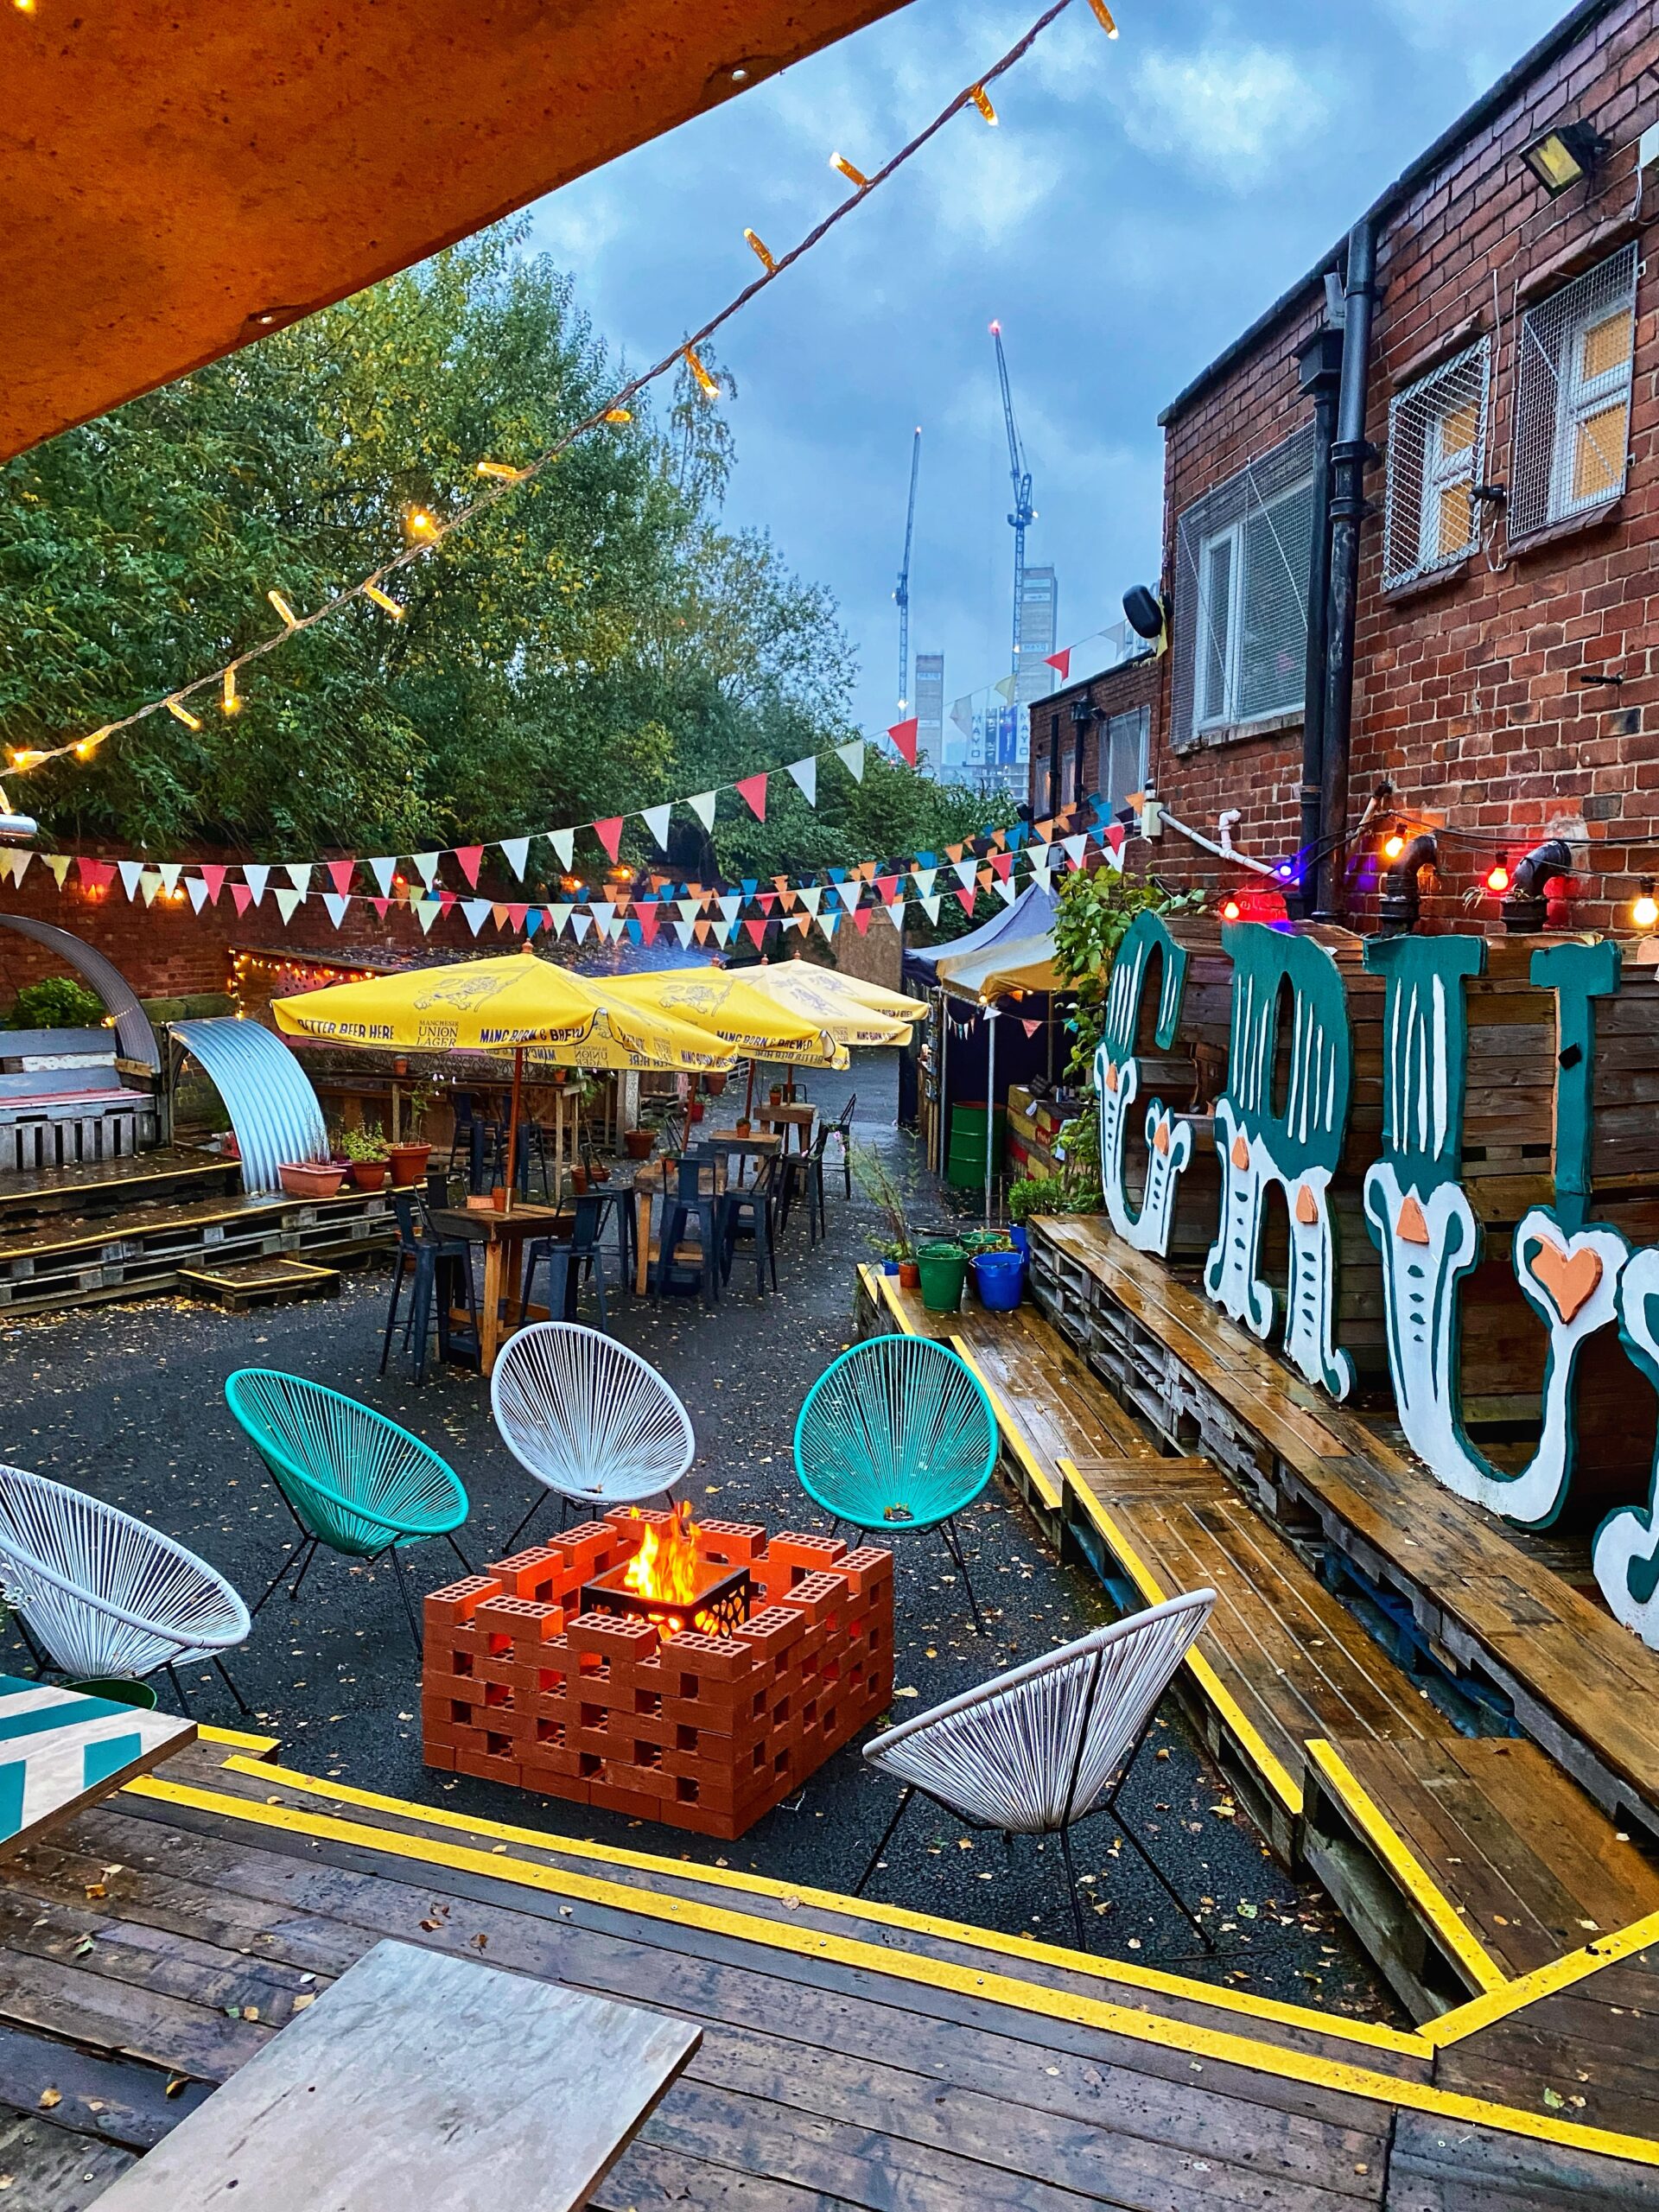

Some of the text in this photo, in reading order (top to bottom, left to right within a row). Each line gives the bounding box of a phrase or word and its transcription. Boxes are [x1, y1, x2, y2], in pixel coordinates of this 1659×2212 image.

[971, 715, 982, 758] MAYO
[1020, 713, 1029, 756] MAYO
[339, 1023, 365, 1038] BEER
[369, 1025, 394, 1039] HERE
[418, 1027, 458, 1038] UNION
[480, 1029, 509, 1043] MANC
[509, 1029, 537, 1042] BORN
[716, 1031, 741, 1042] MANC
[743, 1033, 767, 1046] BORN
[416, 1037, 456, 1046] LAGER
